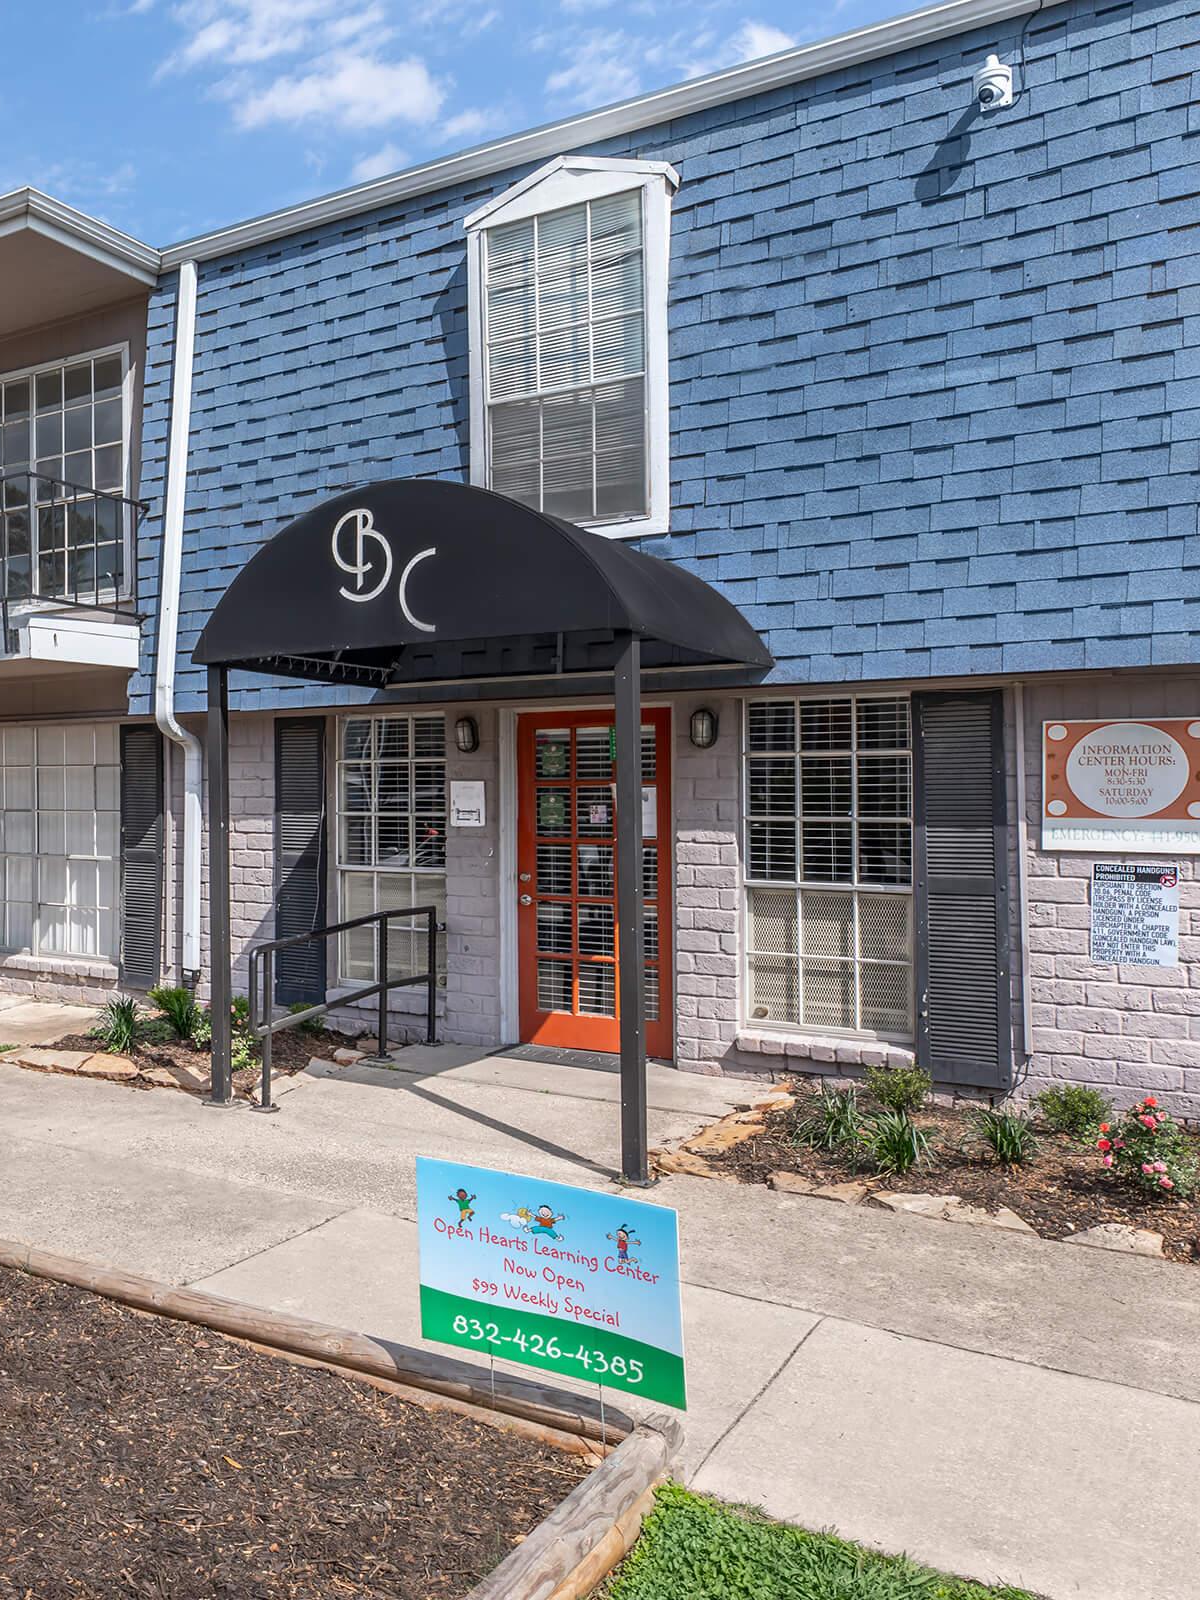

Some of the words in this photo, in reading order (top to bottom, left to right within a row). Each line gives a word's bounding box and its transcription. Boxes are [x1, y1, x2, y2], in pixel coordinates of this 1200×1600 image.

[1083, 744, 1172, 755] INFORMATION
[1078, 756, 1125, 767] CENTER
[1129, 756, 1176, 766] HOURS:
[1104, 768, 1148, 777] MON-FRI
[1106, 777, 1146, 785] 8:30-5:30
[1099, 788, 1154, 797] SATURDAY
[1105, 797, 1149, 806] 10:00-5:00
[1051, 827, 1145, 842] EMERGENCY:
[1095, 865, 1135, 873] CONCEALED
[1136, 866, 1175, 875] HANDGUNS
[1095, 873, 1136, 881] PROHIBITED
[1094, 881, 1126, 889] PURSUANT
[1136, 883, 1162, 891] SECTION
[1135, 890, 1152, 898] CODE
[1137, 897, 1162, 905] LICENSE
[1118, 902, 1133, 910] WITH
[1141, 904, 1178, 912] CONCEALED
[1093, 914, 1122, 922] LICENSED
[1124, 916, 1145, 924] UNDER
[1134, 910, 1160, 918] PERSON
[1093, 920, 1132, 930] SUBCHAPTER
[1142, 924, 1170, 932] CHAPTER
[1107, 928, 1150, 938] GOVERNMENT
[1129, 937, 1159, 945] HANDGUN
[1093, 947, 1123, 956] PROPERTY
[1092, 954, 1128, 963] CONCEALED
[1129, 957, 1160, 965] HANDGUN
[434, 1217, 473, 1240] Open
[479, 1226, 528, 1251] Hearts
[534, 1238, 598, 1272] Learning
[604, 1256, 659, 1284] Center
[503, 1257, 537, 1278] Now
[543, 1266, 585, 1292] Open
[472, 1278, 498, 1296] $99
[503, 1283, 558, 1314] Weekly
[564, 1296, 620, 1327] Special
[452, 1315, 644, 1383] 832-426-4385
